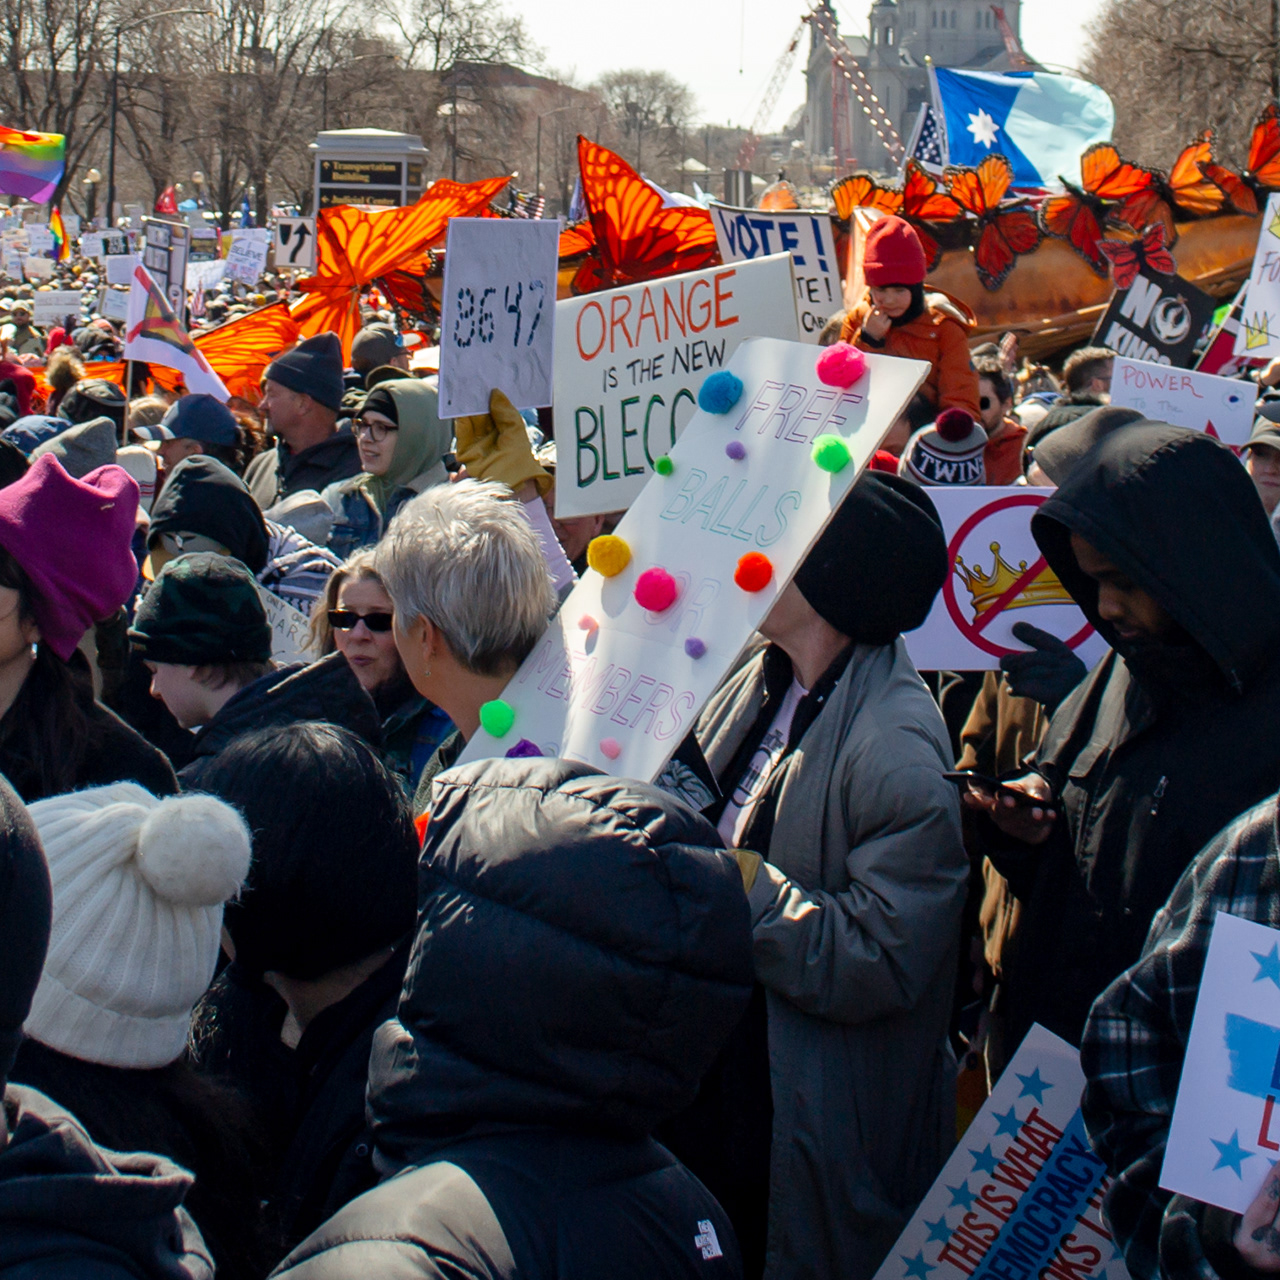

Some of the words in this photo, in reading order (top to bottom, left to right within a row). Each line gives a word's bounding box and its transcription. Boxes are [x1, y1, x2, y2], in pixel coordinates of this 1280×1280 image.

[332, 161, 396, 172] Transportation
[332, 172, 370, 183] Building
[331, 195, 365, 204] Judicial
[366, 195, 395, 205] Center
[231, 245, 264, 261] BELIEVE
[576, 269, 739, 361] ORANGE
[603, 367, 618, 392] IS
[627, 354, 664, 385] THE
[672, 339, 725, 374] NEW
[1121, 365, 1204, 399] POWER
[735, 380, 863, 445] FREE
[919, 451, 983, 482] TWIN
[659, 467, 802, 548] BALLS
[519, 639, 696, 741] MEMBERS
[991, 1107, 1065, 1193] WHAT
[974, 1183, 1018, 1223] IS
[937, 1211, 1001, 1276] THIS
